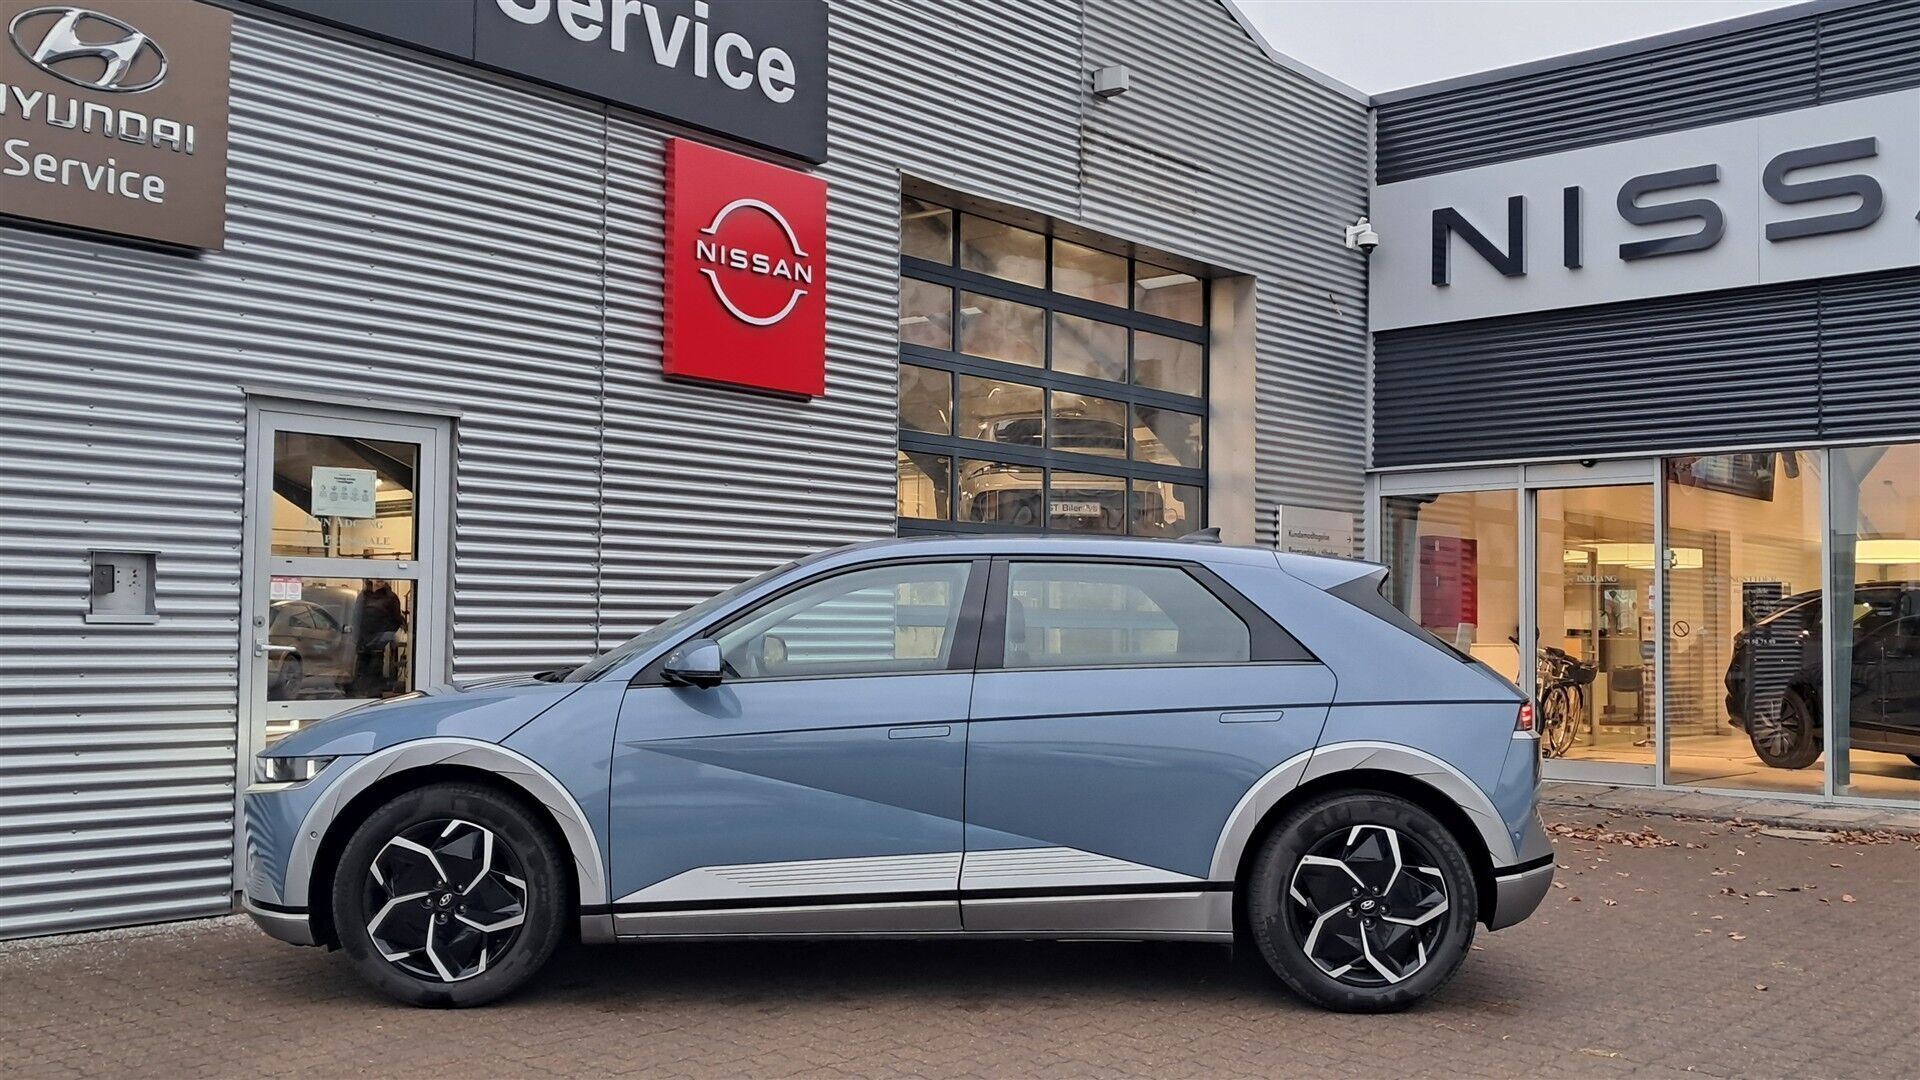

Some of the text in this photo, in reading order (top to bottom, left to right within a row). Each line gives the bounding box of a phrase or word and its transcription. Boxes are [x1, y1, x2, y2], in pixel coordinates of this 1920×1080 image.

[0, 83, 195, 155] YUNDAI
[3, 138, 166, 204] Service
[1431, 136, 1920, 287] NISS
[696, 239, 812, 284] NISSAN
